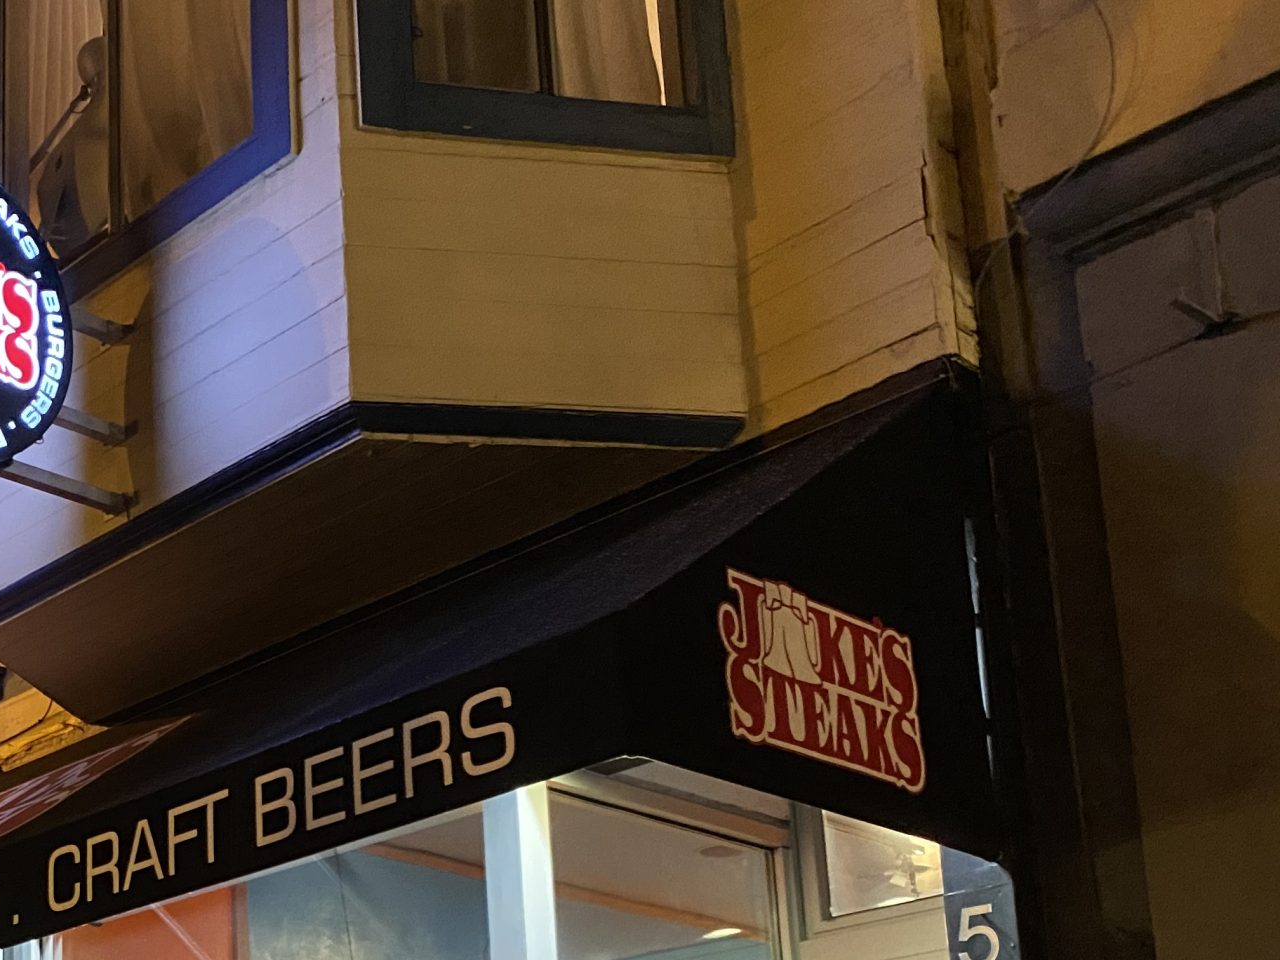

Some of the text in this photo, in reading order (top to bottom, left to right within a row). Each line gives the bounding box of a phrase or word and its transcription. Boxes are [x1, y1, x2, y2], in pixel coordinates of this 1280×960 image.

[21, 290, 64, 428] BURGERS
[727, 655, 925, 792] STEAKS
[47, 790, 229, 912] CRAFT
[255, 687, 515, 847] BEERS
